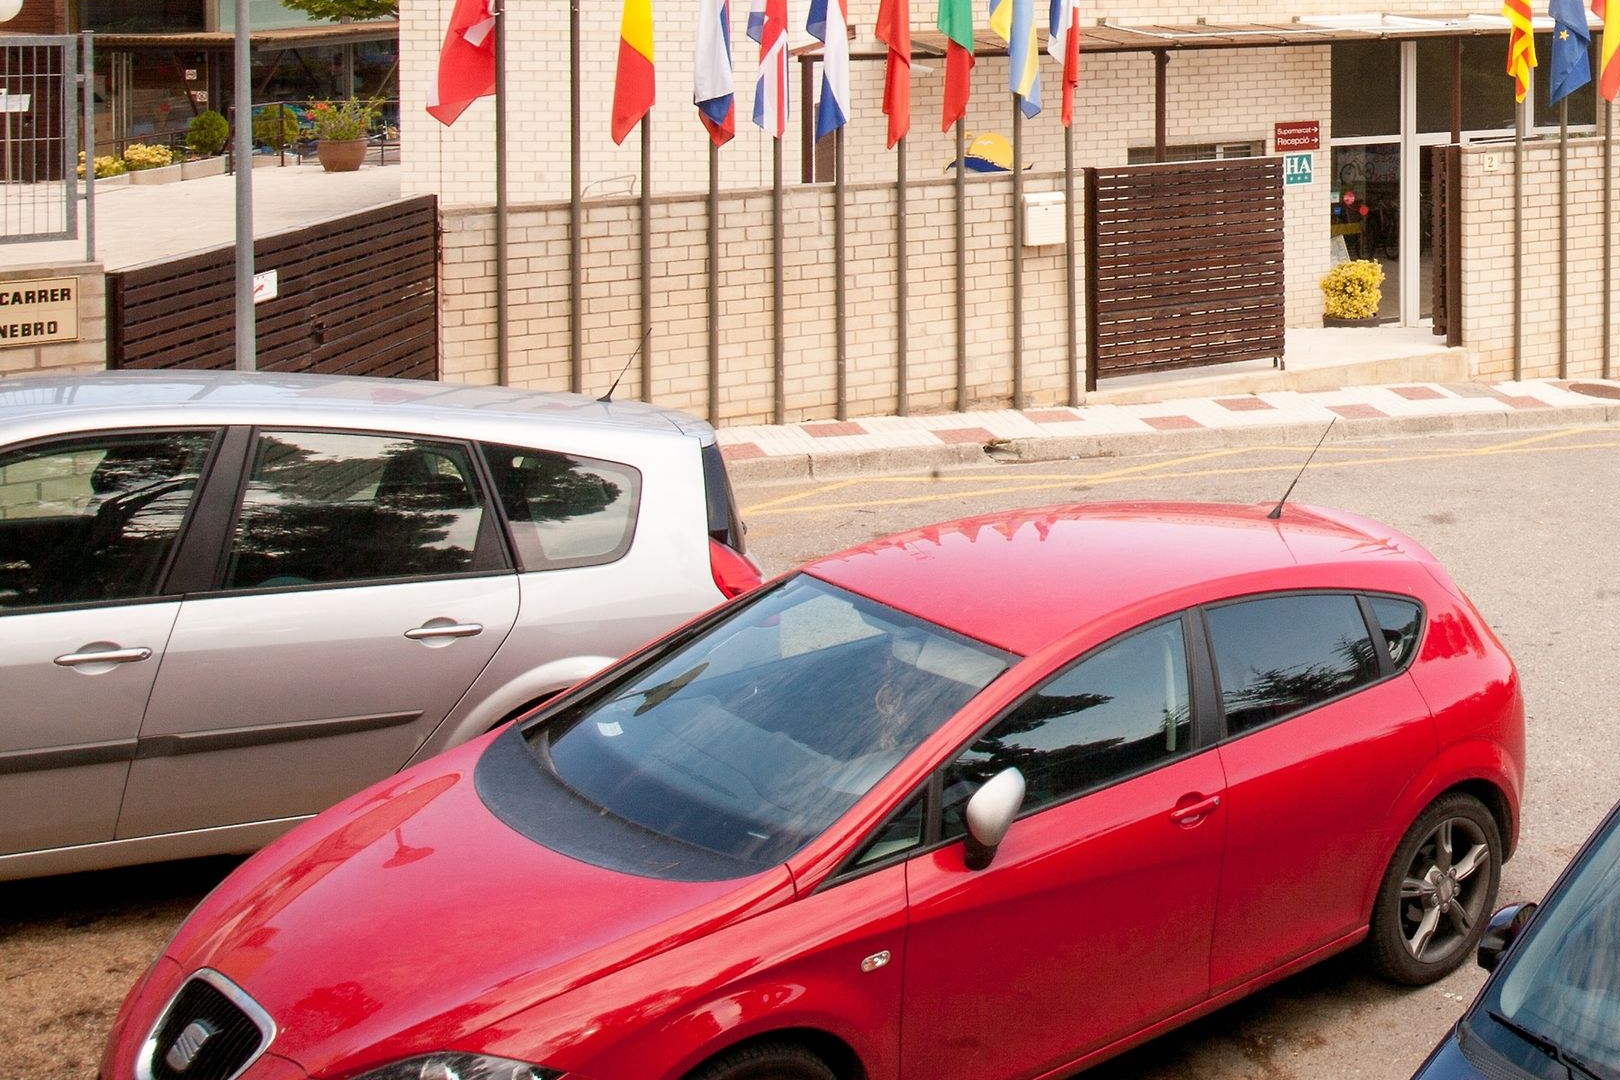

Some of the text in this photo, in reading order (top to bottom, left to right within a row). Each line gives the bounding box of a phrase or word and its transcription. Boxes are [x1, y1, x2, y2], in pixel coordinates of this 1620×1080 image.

[1286, 156, 1312, 175] HA
[1487, 156, 1494, 168] 2
[0, 288, 71, 306] CARRER
